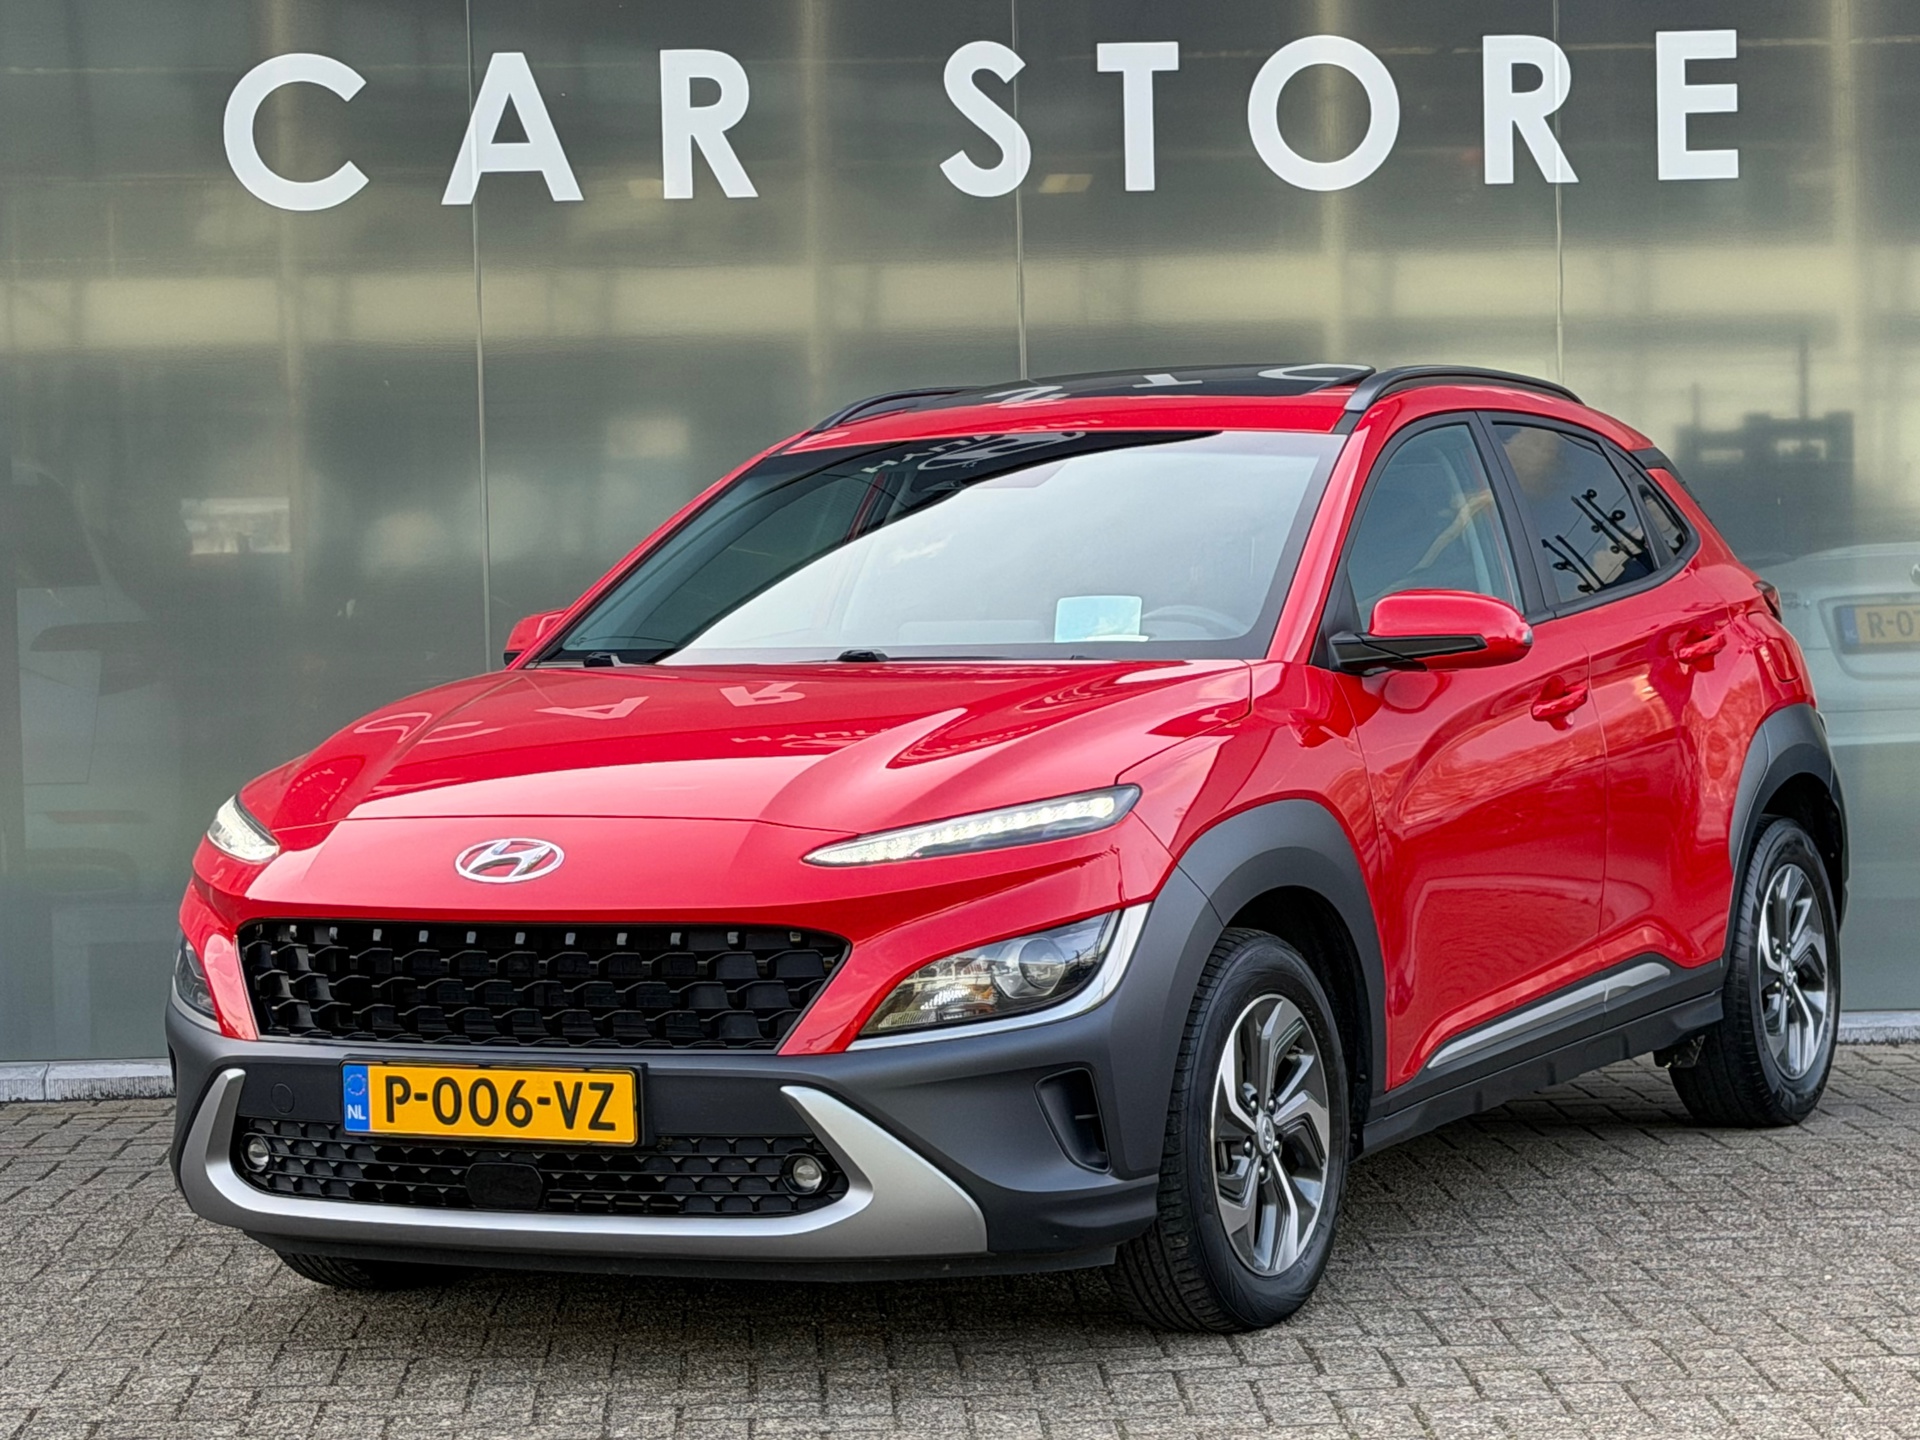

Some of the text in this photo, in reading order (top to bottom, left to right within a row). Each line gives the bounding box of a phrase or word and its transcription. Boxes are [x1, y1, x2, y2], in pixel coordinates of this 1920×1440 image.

[223, 29, 1739, 211] CAR STORE
[1867, 610, 1920, 638] R-0
[347, 1104, 367, 1120] NL
[384, 1075, 616, 1131] P-006-VZ
